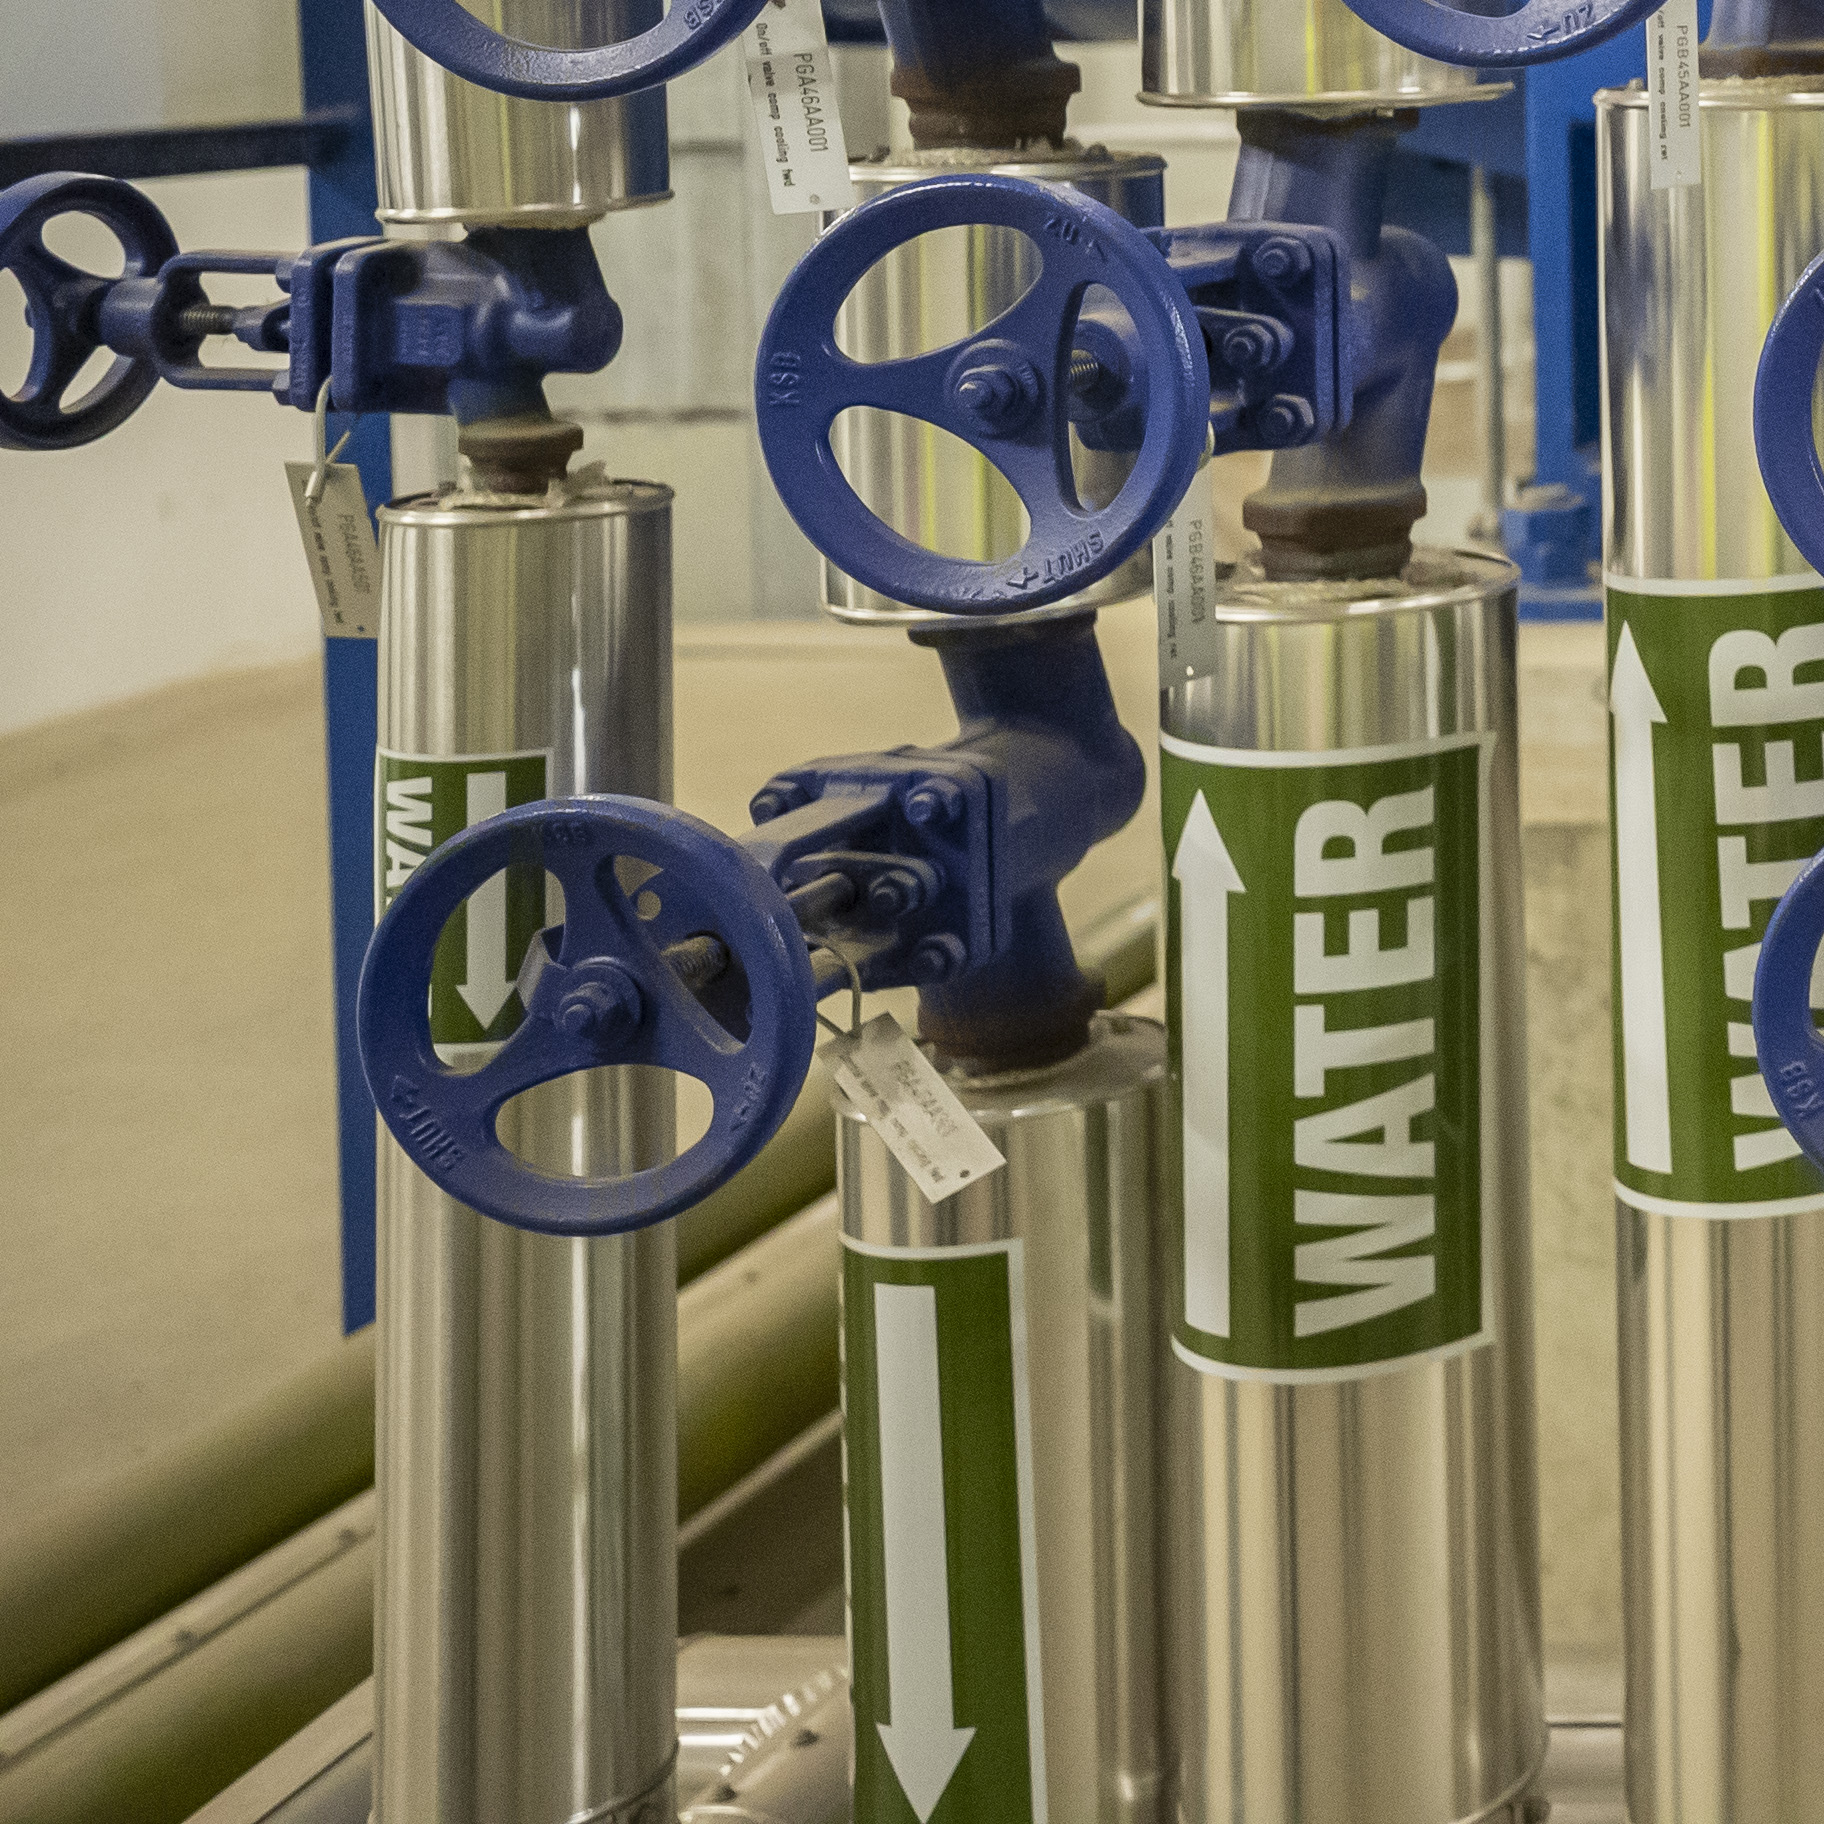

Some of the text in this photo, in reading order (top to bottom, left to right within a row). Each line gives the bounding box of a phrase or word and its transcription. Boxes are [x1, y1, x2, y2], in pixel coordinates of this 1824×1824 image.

[793, 52, 829, 152] PGA46AA001
[769, 352, 801, 406] KSB
[1042, 530, 1106, 585] SHUT
[1294, 784, 1435, 1338] WATER
[1779, 1059, 1823, 1117] KSB
